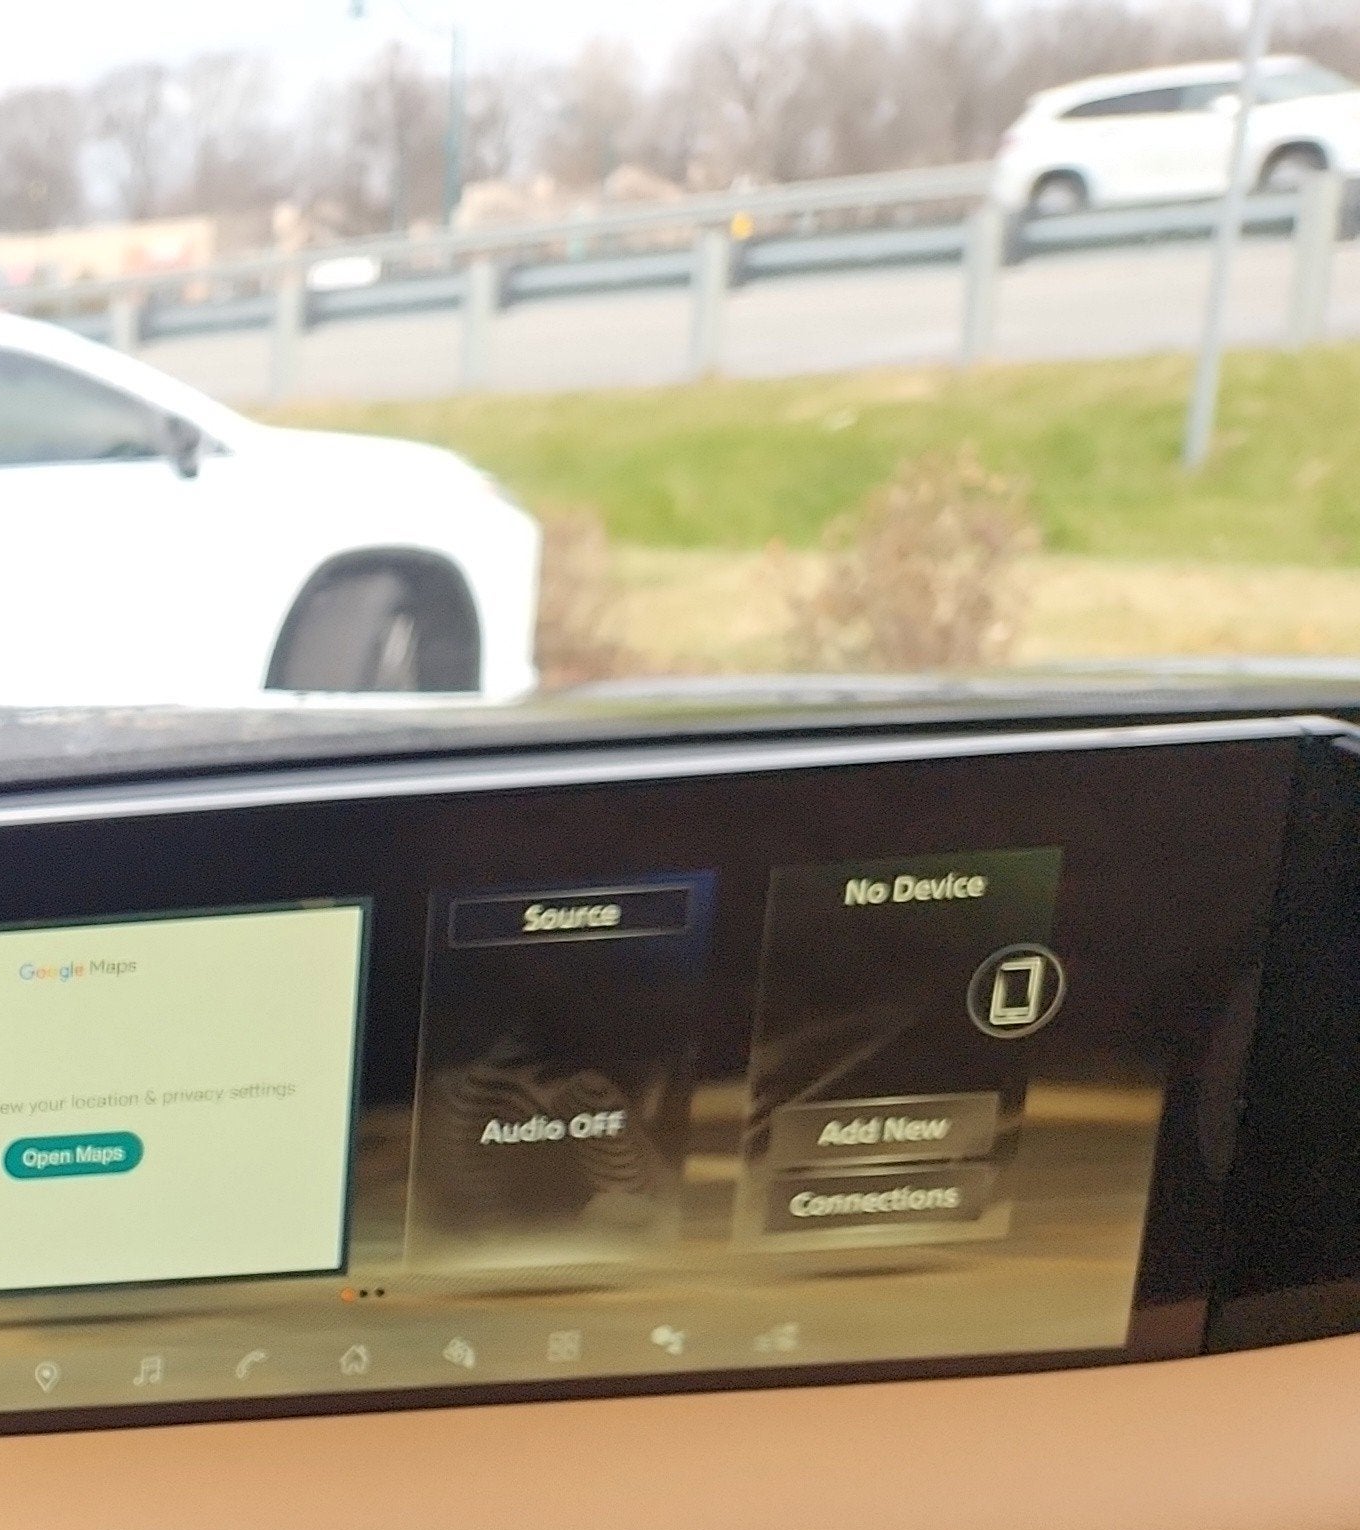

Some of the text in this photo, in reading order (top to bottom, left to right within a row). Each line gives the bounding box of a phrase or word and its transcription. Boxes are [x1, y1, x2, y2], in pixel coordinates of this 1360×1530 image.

[845, 872, 986, 905] No Device
[522, 902, 622, 932] Source
[19, 958, 137, 982] Google Maps
[28, 1100, 66, 1117] your
[71, 1091, 139, 1110] location
[144, 1090, 157, 1106] &
[162, 1088, 224, 1107] privacy
[229, 1081, 296, 1099] settings
[481, 1116, 564, 1145] Audio
[818, 1115, 951, 1145] Add New
[22, 1144, 125, 1169] Open Maps
[790, 1185, 960, 1217] Connections
